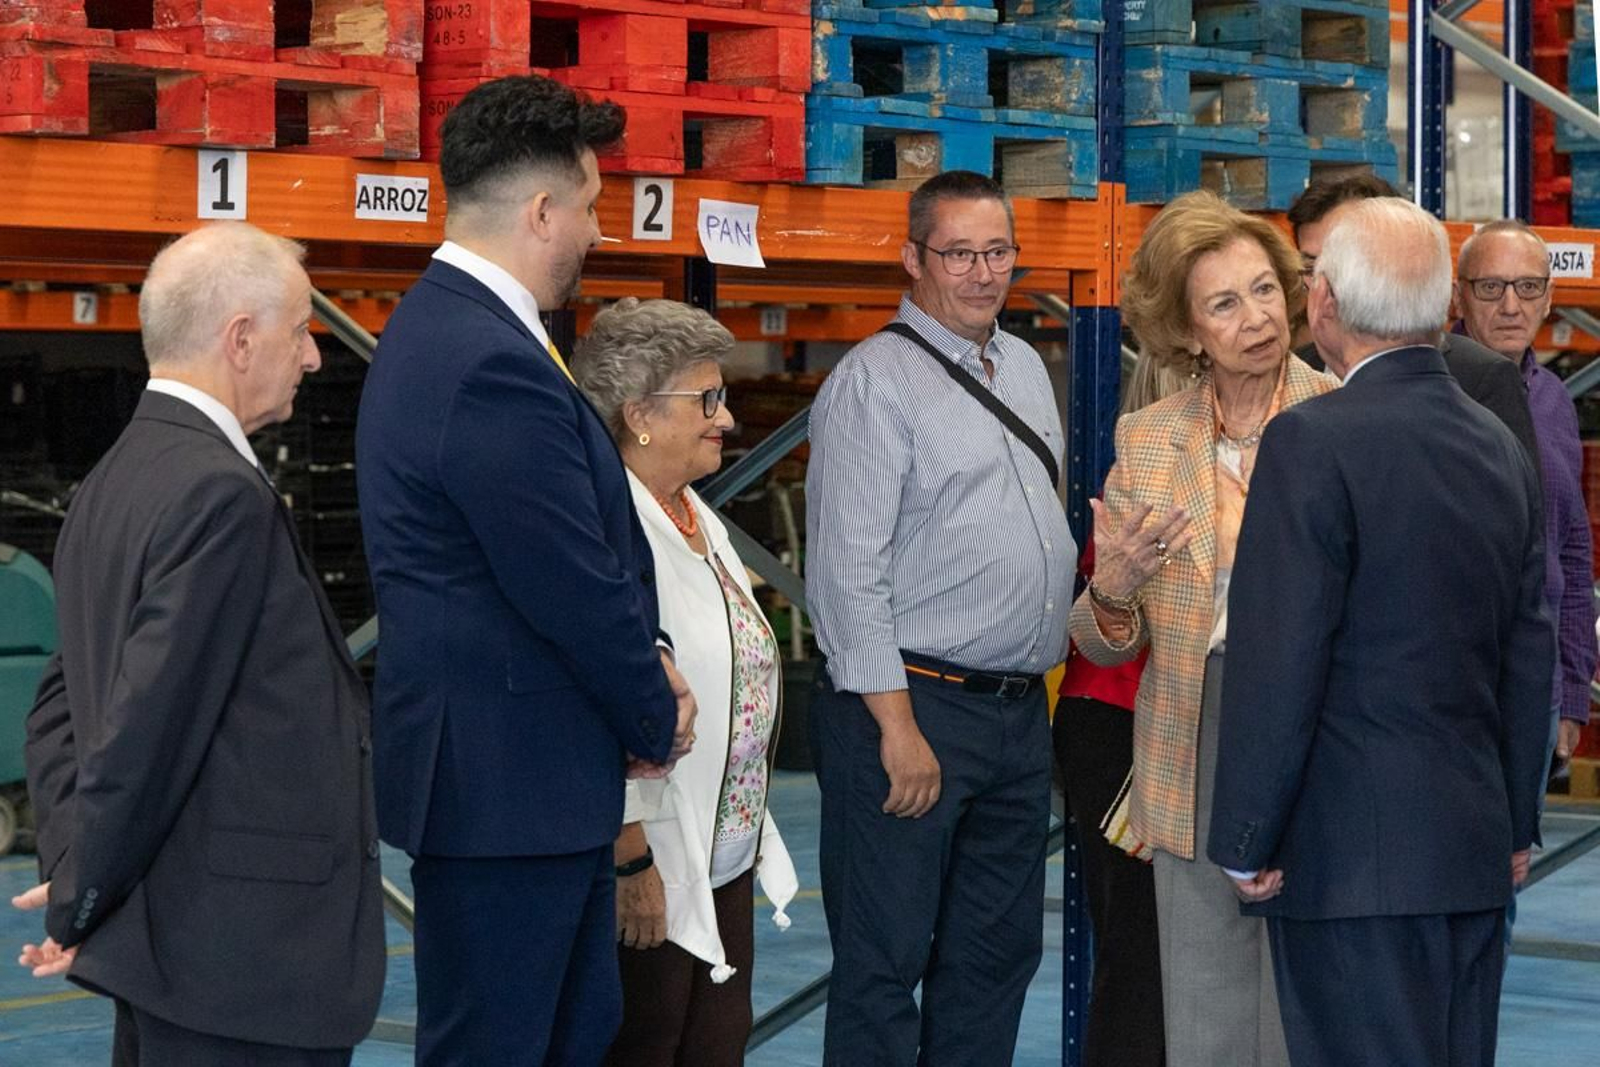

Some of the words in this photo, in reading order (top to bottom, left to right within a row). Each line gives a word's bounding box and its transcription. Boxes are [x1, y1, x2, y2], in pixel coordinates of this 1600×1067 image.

[212, 158, 235, 210] 1
[357, 185, 428, 213] ARROZ
[643, 184, 663, 232] 2
[706, 214, 752, 247] PAN
[80, 297, 92, 319] 7
